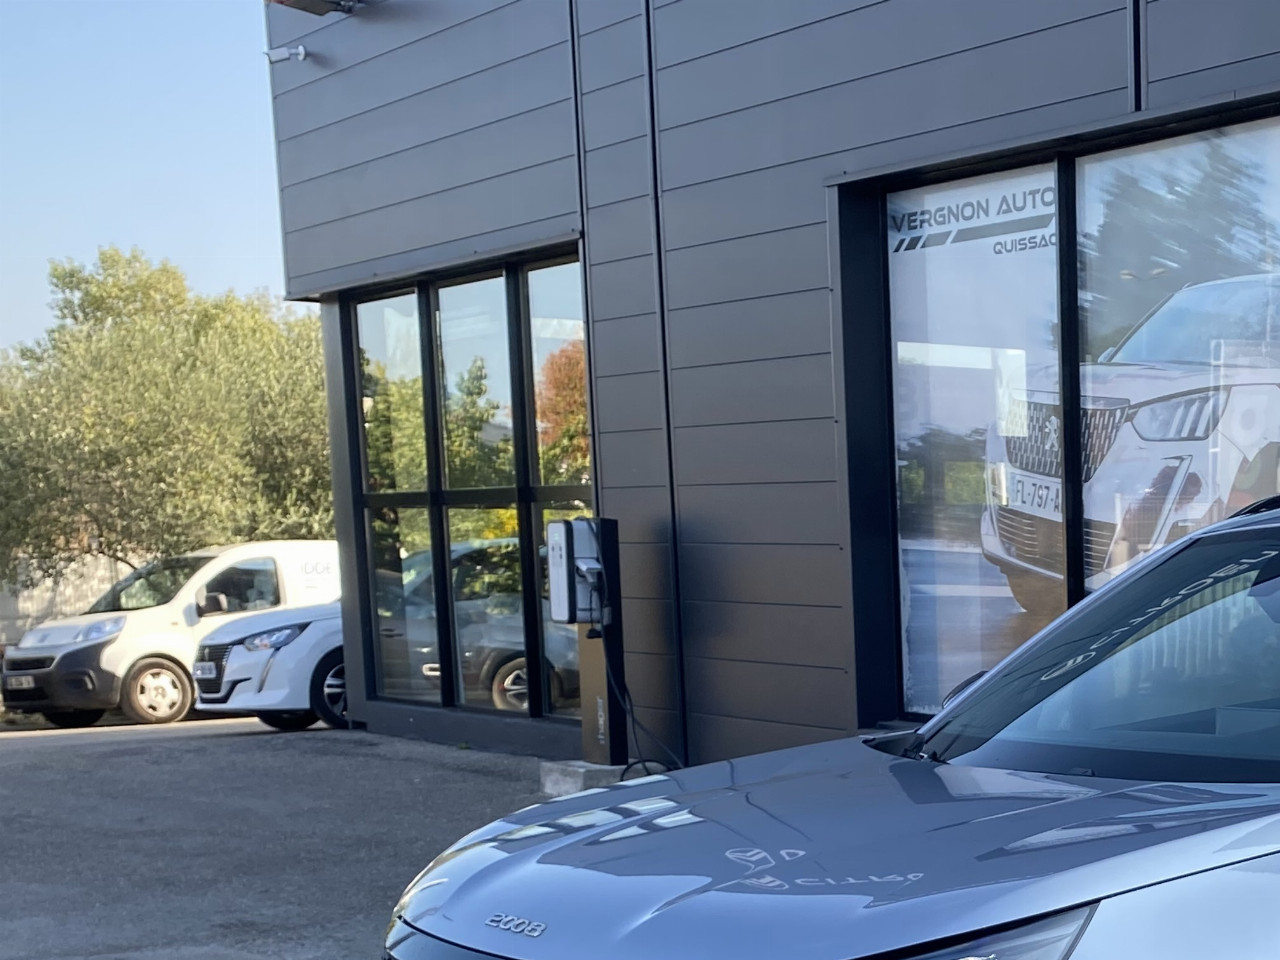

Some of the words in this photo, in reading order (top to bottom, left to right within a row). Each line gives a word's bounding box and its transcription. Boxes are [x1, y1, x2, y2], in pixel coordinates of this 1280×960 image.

[892, 198, 989, 233] VERGNON
[996, 186, 1056, 216] AUTO
[485, 912, 546, 937] 2008
